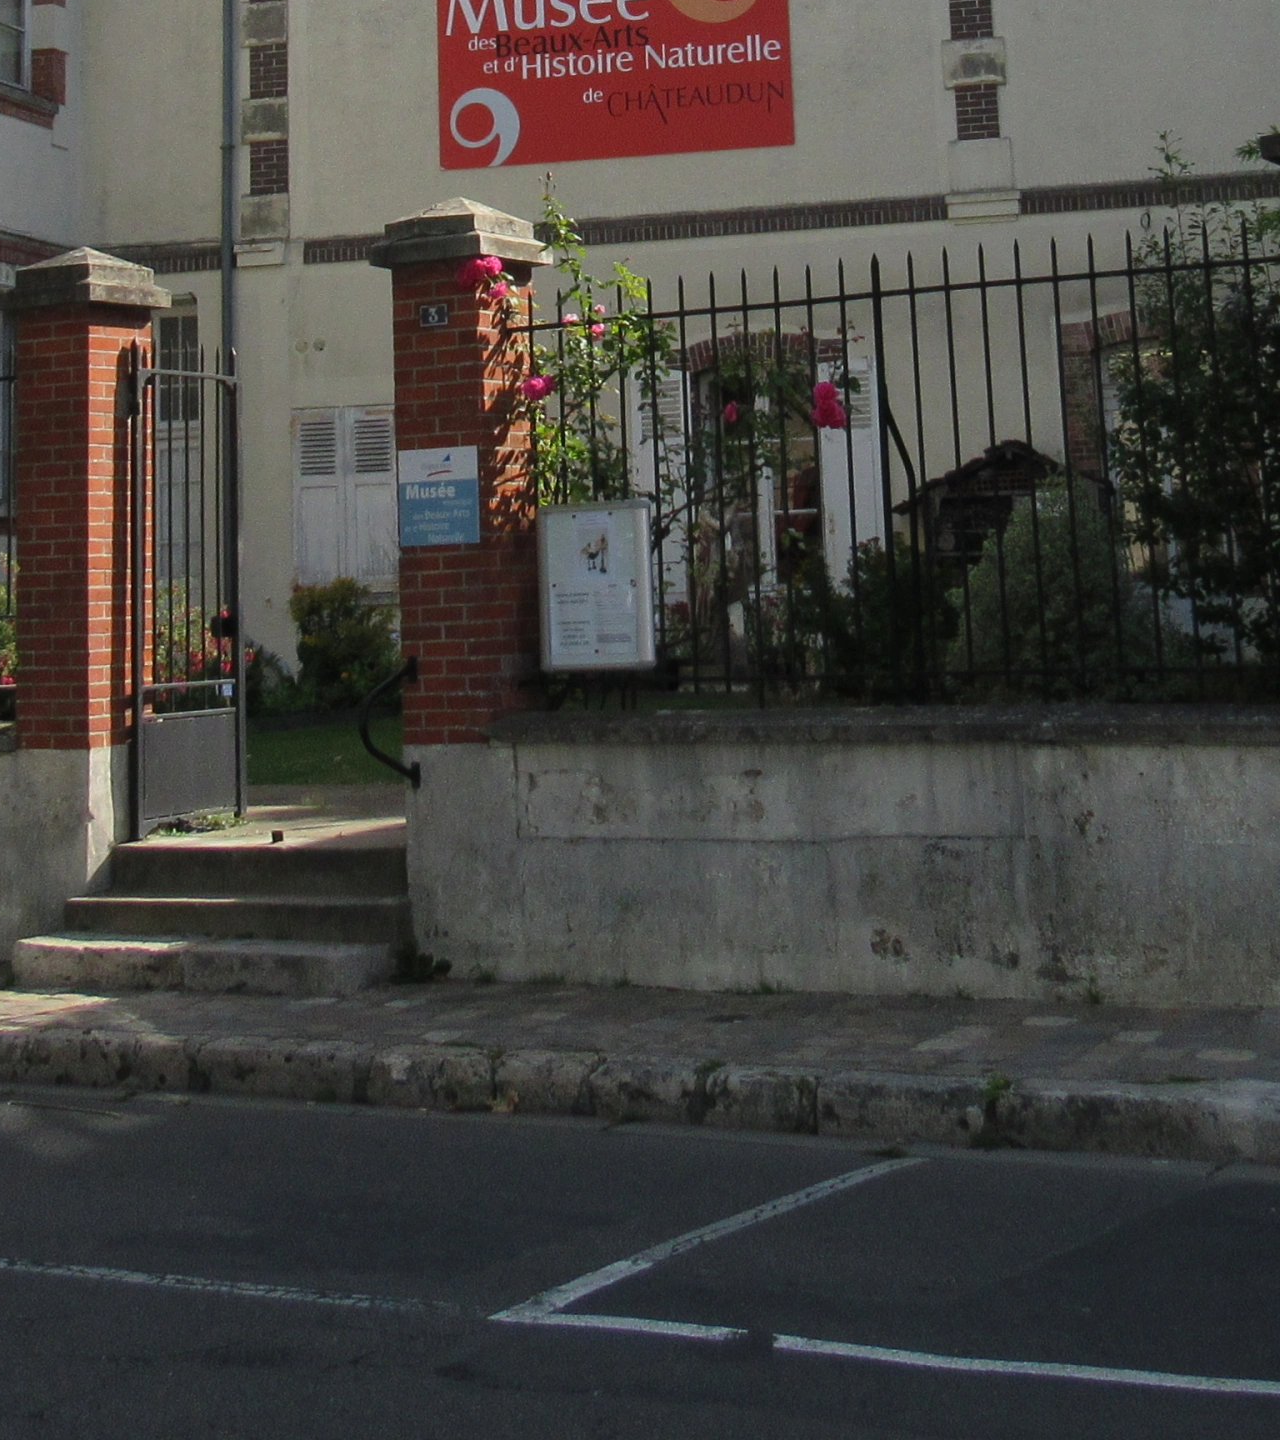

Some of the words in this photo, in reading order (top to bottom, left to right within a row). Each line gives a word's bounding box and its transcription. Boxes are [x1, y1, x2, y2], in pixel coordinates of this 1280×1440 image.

[468, 35, 497, 51] des
[495, 25, 650, 58] Beaux-Arts
[483, 60, 499, 74] et
[645, 34, 782, 70] Naturelle
[583, 88, 604, 104] de
[607, 80, 785, 124] CHÂTEAUDUN
[428, 307, 439, 323] 3
[405, 481, 456, 500] Musée
